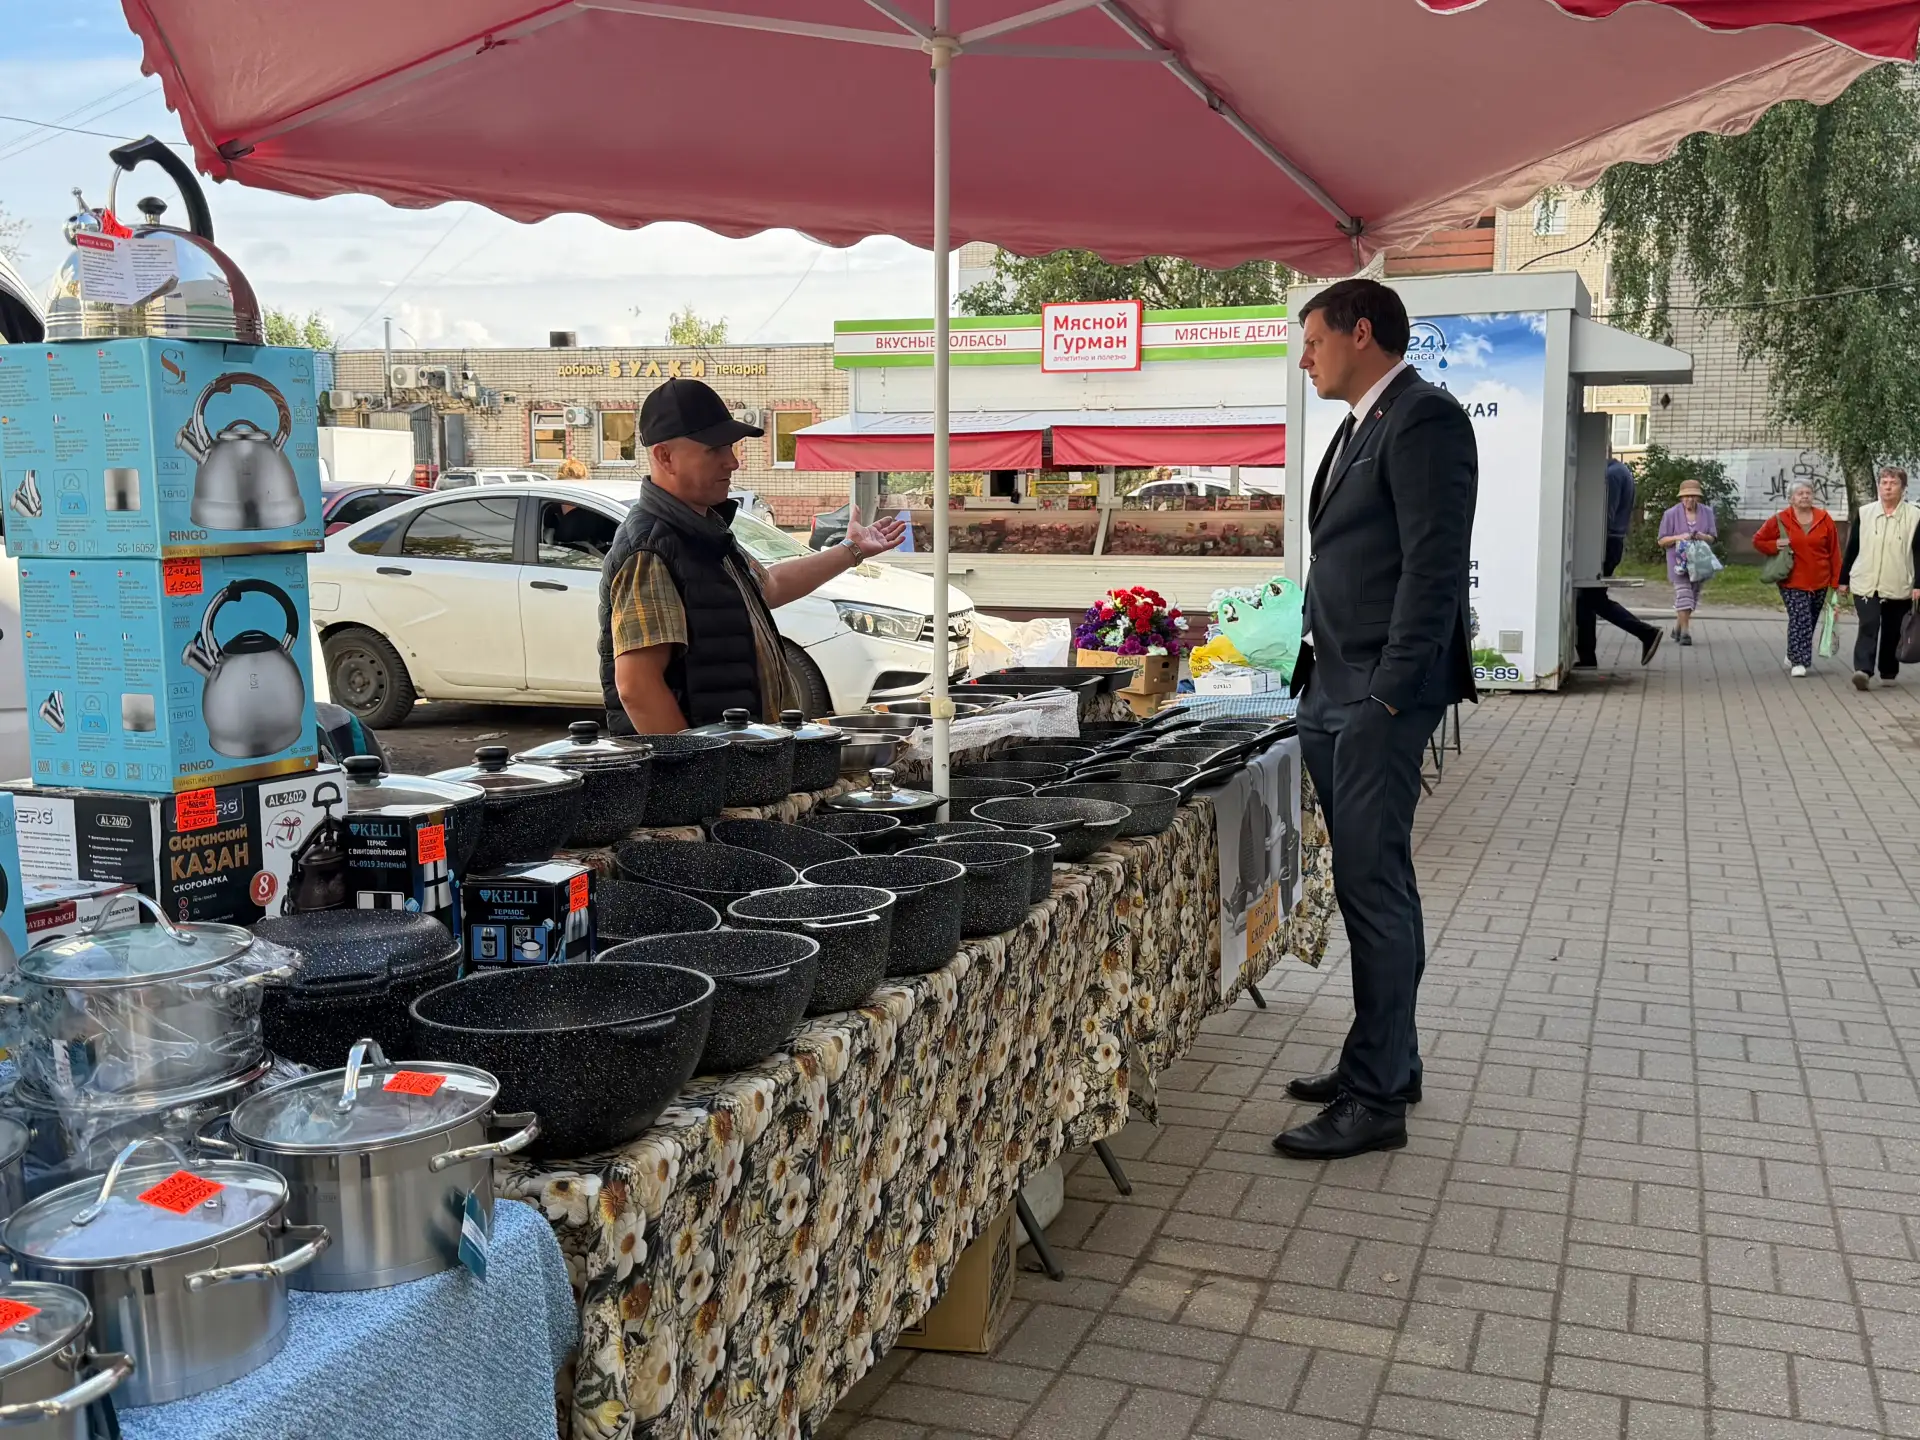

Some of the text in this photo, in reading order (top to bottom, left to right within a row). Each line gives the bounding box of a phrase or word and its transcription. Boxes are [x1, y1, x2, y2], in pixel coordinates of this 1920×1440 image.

[1053, 312, 1127, 331] Мясной
[1175, 326, 1240, 340] МЯСНЫЕ
[876, 334, 1006, 349] ВКУСНЫЕ ОЛБАСЫ
[1053, 334, 1127, 354] Гурман
[1408, 335, 1435, 351] 24
[1407, 353, 1435, 361] часа
[558, 359, 766, 378] добрые БУЛКИ пекарня
[169, 530, 208, 542] RINGO
[117, 543, 155, 553] SG-16052
[1115, 656, 1140, 667] Global
[180, 759, 214, 773] RINGO
[269, 790, 304, 807] AL-2602
[100, 815, 128, 827] AL-2602
[360, 823, 402, 838] KELLI
[366, 839, 387, 847] ТЕРМОС
[353, 847, 381, 856] ВИНТОВОЙ
[382, 848, 406, 856] ПРОБКОЙ
[170, 842, 249, 881] КАЗАН
[172, 874, 229, 893] СКОРОВАРКА
[259, 875, 269, 895] 8
[491, 889, 538, 904] KELLI
[55, 911, 75, 923] BOCH
[494, 908, 524, 916] ТЕРМОС
